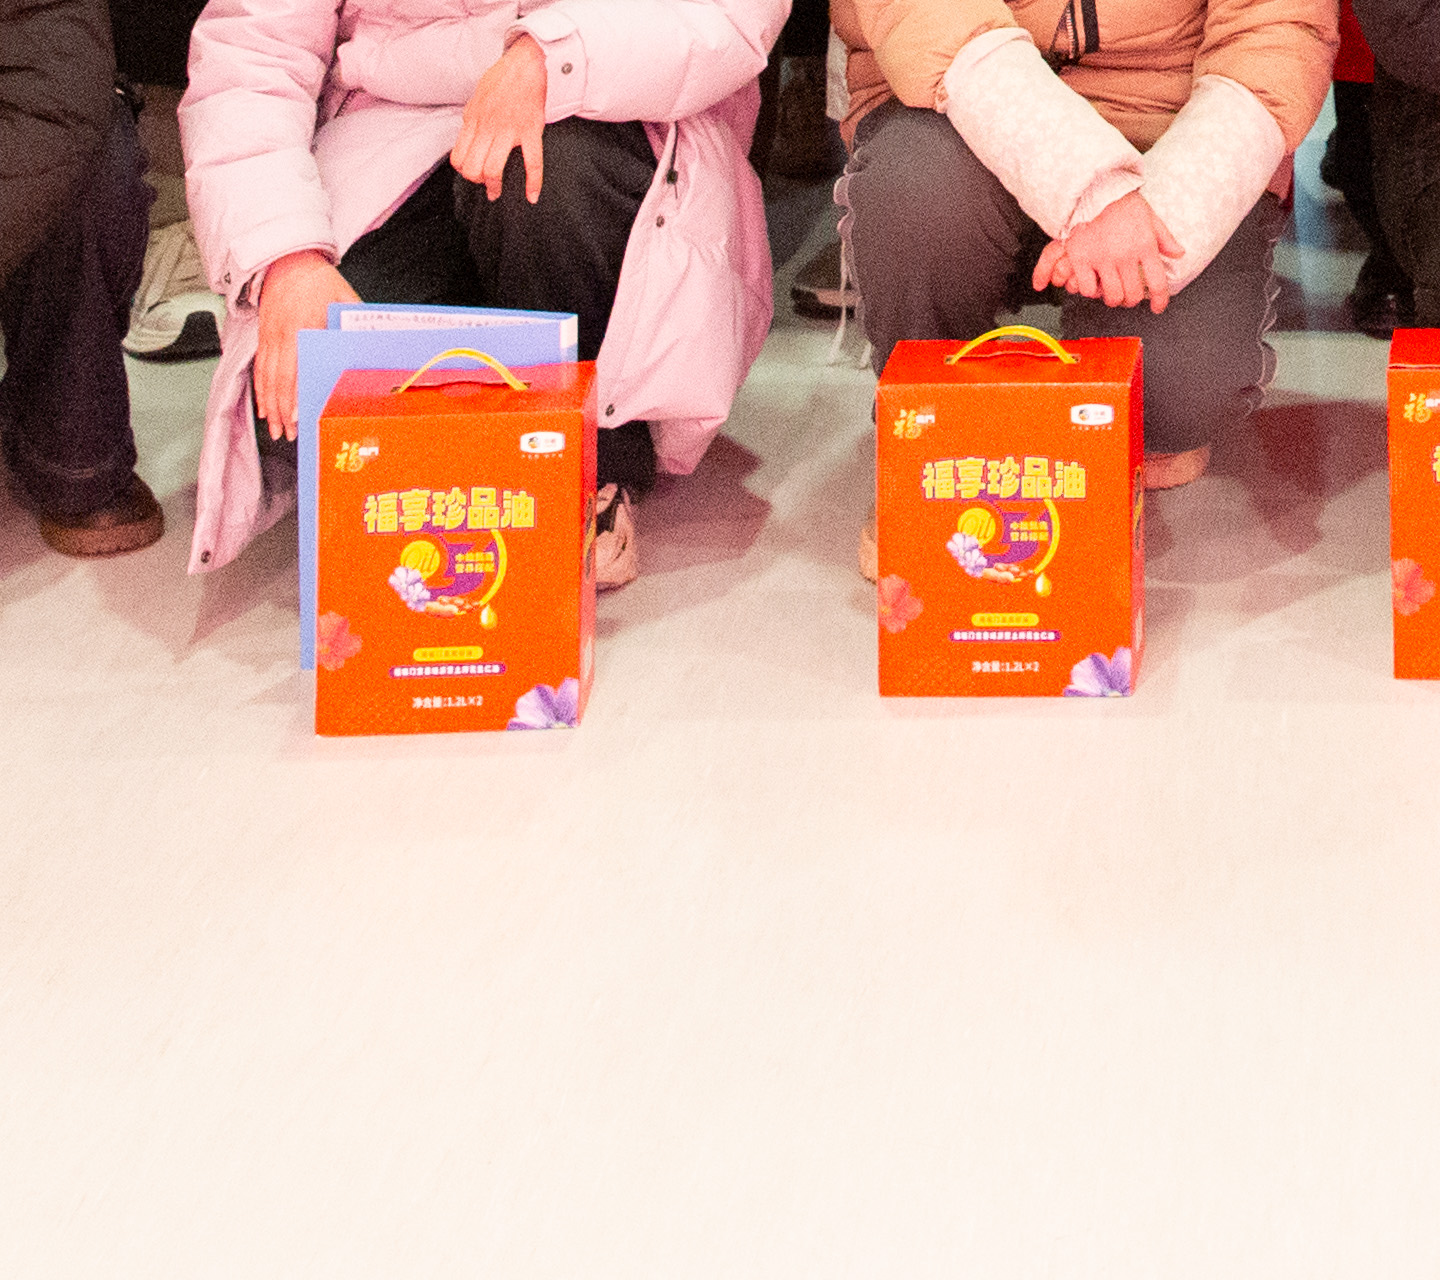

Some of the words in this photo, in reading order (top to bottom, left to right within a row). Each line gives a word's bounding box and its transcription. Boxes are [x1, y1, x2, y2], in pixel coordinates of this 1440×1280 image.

[922, 456, 1088, 499] 福享珍品油
[363, 486, 536, 532] 福享珍品油
[404, 547, 437, 573] Oil
